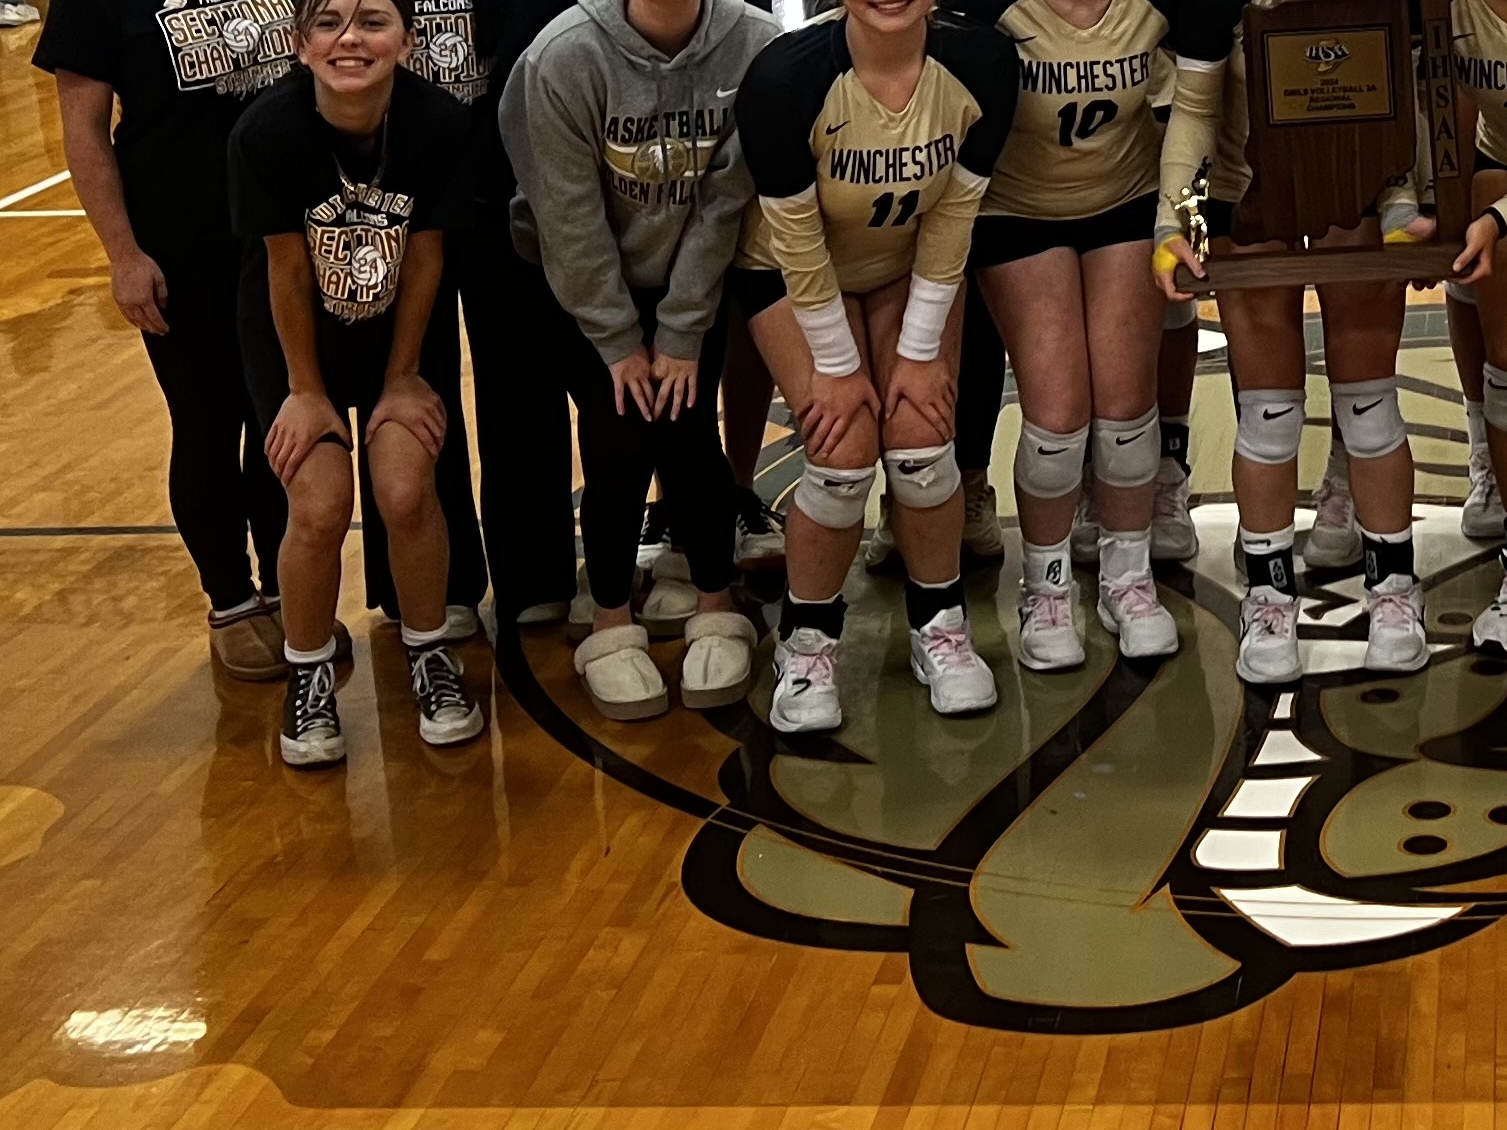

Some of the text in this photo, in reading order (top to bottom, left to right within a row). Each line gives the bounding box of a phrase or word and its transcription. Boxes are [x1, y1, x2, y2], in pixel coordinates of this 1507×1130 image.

[1019, 51, 1150, 94] WINCHESTER
[1430, 25, 1457, 172] IHSAA
[1057, 99, 1119, 147] 10
[830, 133, 957, 185] WINCHESTER
[867, 189, 919, 229] 11
